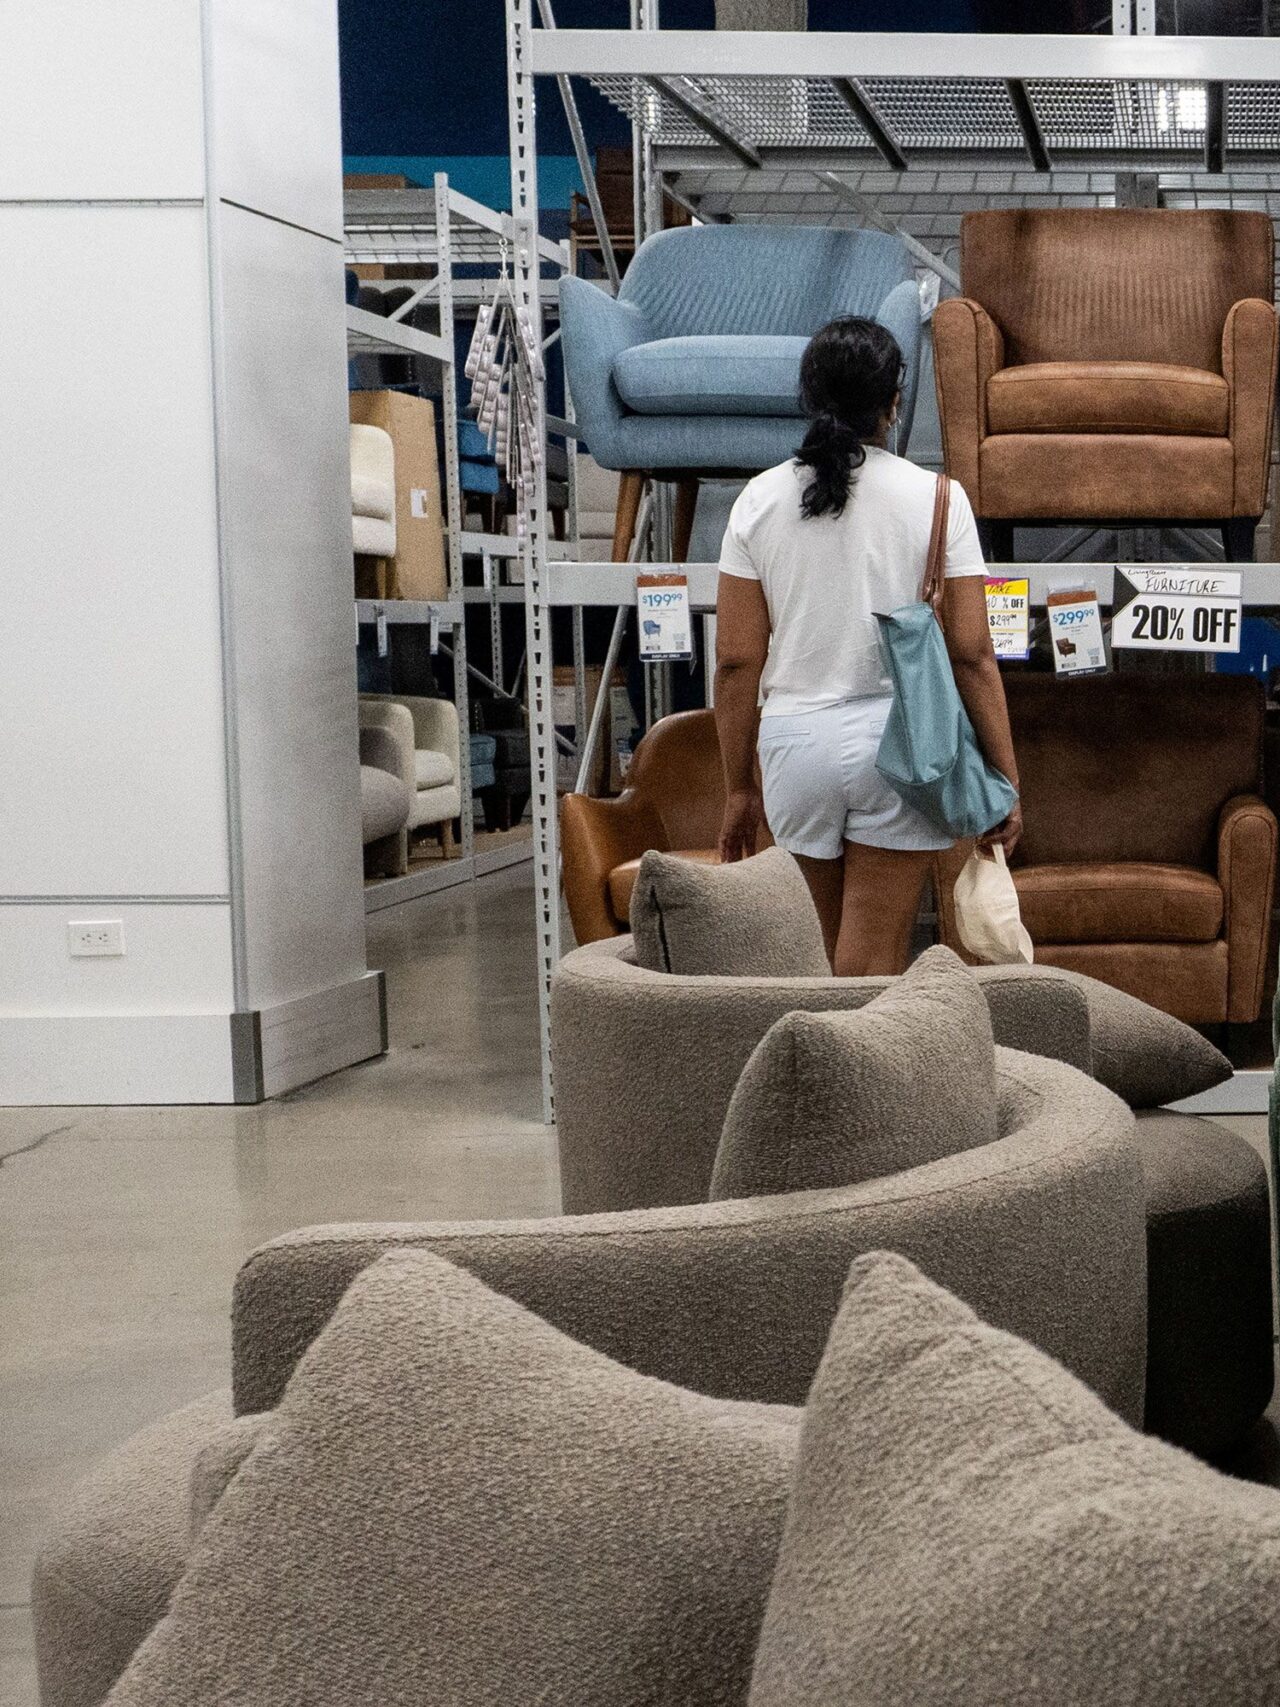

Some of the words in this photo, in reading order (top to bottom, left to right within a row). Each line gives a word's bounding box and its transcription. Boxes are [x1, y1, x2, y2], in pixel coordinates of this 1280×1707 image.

[1144, 577, 1225, 593] FURNITURE
[1010, 598, 1024, 609] OFF
[1132, 604, 1184, 640] 20%
[1193, 607, 1237, 643] OFF
